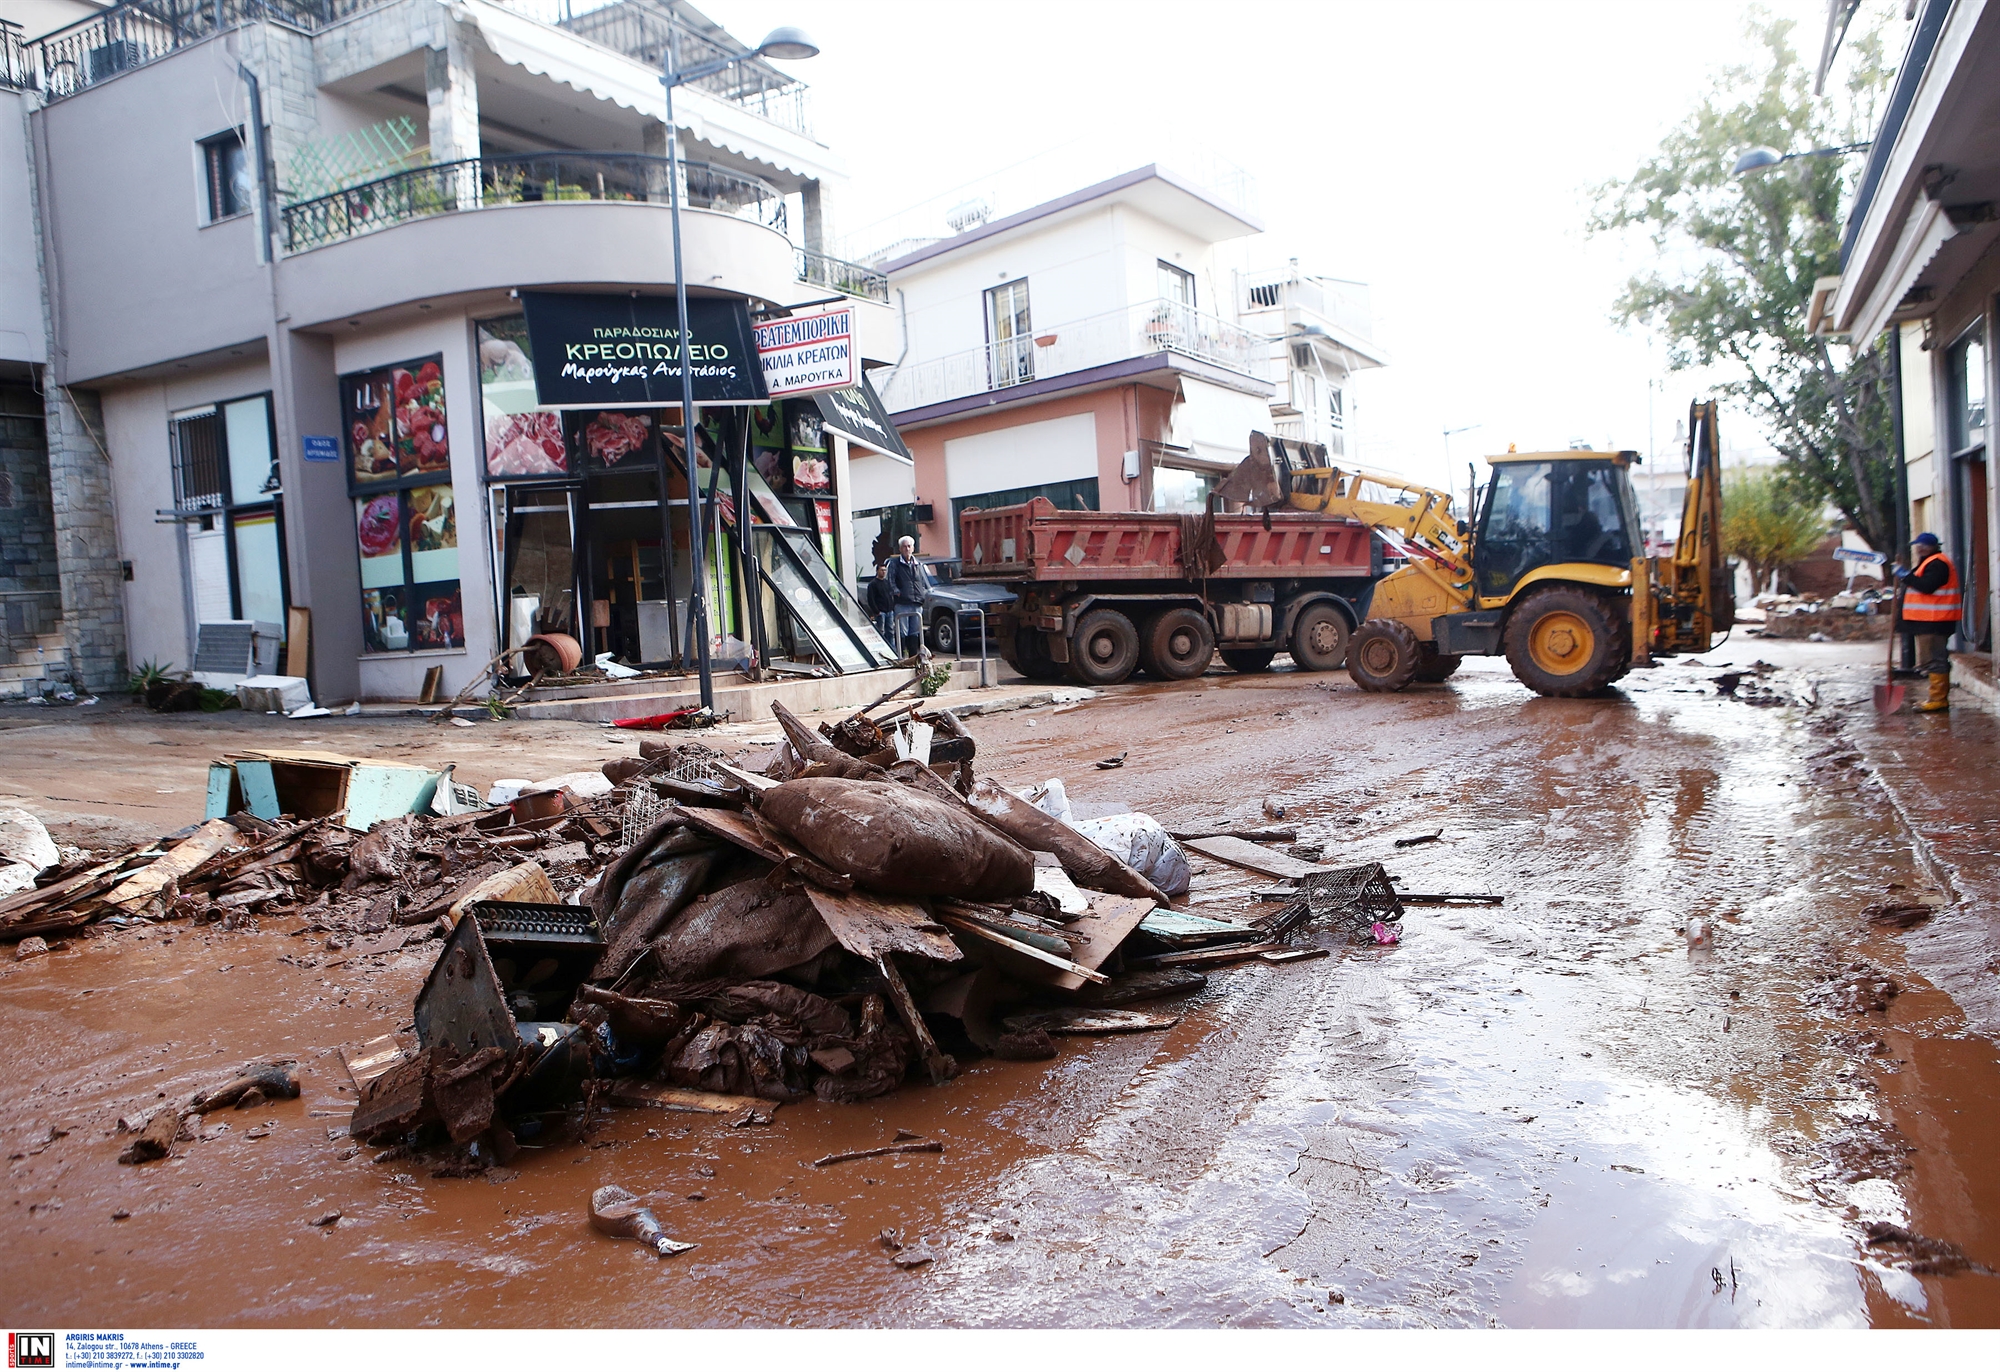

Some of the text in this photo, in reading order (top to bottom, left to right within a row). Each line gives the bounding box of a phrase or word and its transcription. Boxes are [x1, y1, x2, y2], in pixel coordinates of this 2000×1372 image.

[593, 326, 693, 340] ΠΑΡΑΔΟΣΙΑΚΟ
[753, 313, 849, 348] ΡΕΑΤΕΜΠΟΡΙΚΗ
[761, 344, 848, 372] ΙΚΙΛΙΑ ΚΡΕΑΤΩΝ
[561, 362, 648, 384] Μαρούγκας
[772, 368, 843, 388] Α. ΜΑΡΟΥΓΚΑ
